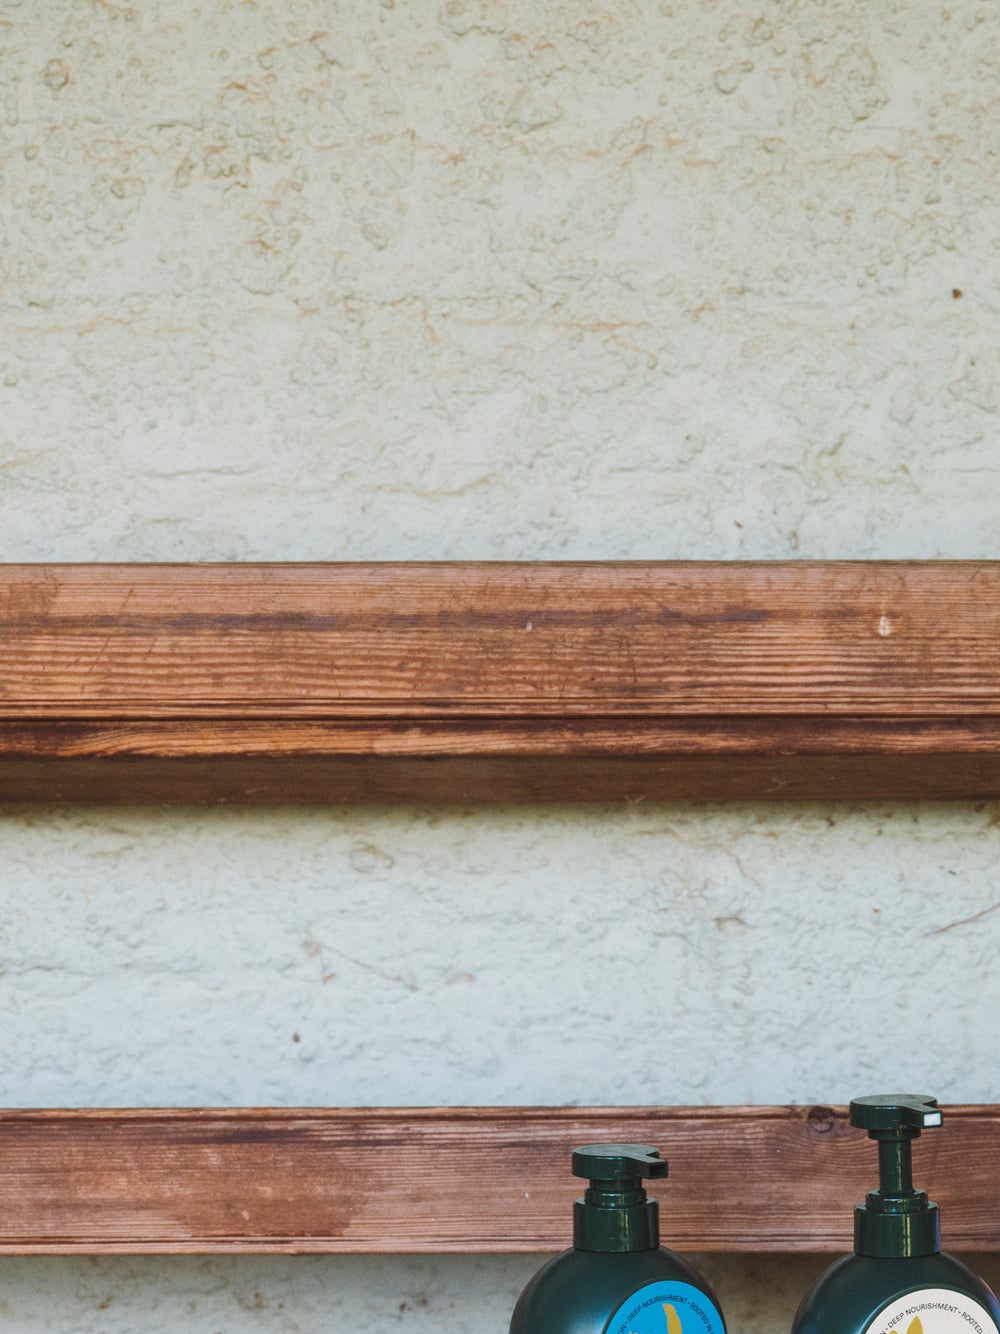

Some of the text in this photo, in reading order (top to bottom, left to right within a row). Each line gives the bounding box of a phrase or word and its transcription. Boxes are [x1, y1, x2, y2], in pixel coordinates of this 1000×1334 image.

[627, 1305, 642, 1322] DEEP
[642, 1294, 689, 1308] NOURISHMENT
[689, 1302, 709, 1325] ROOTED
[887, 1312, 905, 1328] DEEP
[905, 1302, 959, 1316] NOURISHMENT
[961, 1311, 983, 1334] ROOTED
